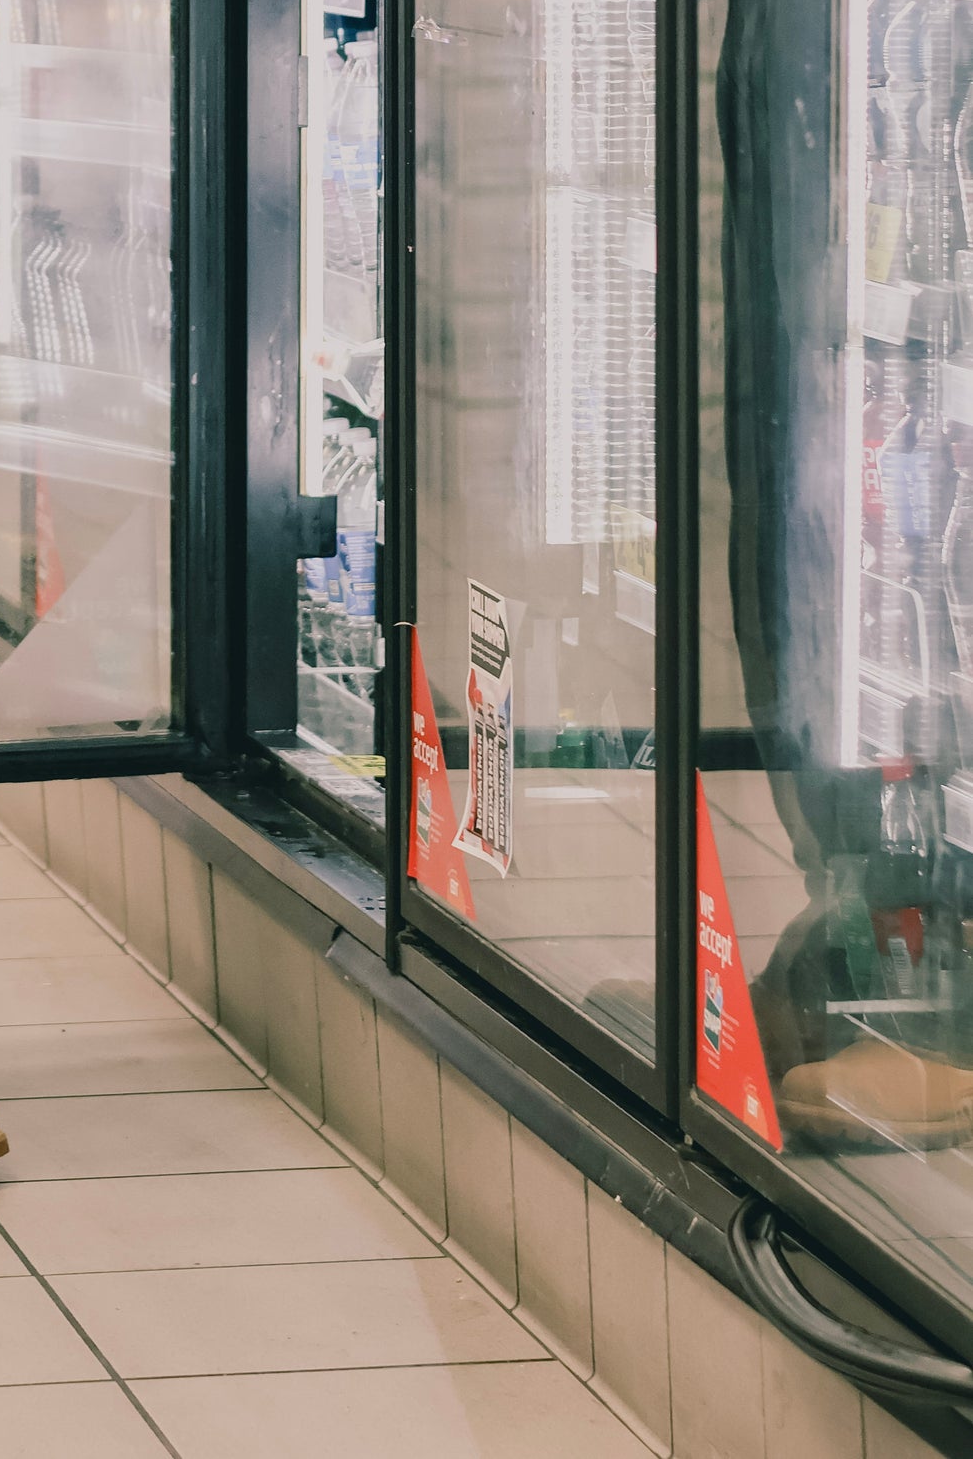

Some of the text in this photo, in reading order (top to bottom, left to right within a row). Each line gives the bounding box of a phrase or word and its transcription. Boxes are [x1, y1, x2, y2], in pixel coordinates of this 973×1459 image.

[413, 711, 425, 736] we
[413, 737, 439, 775] accept
[699, 890, 715, 922] we
[700, 921, 733, 968] accept
